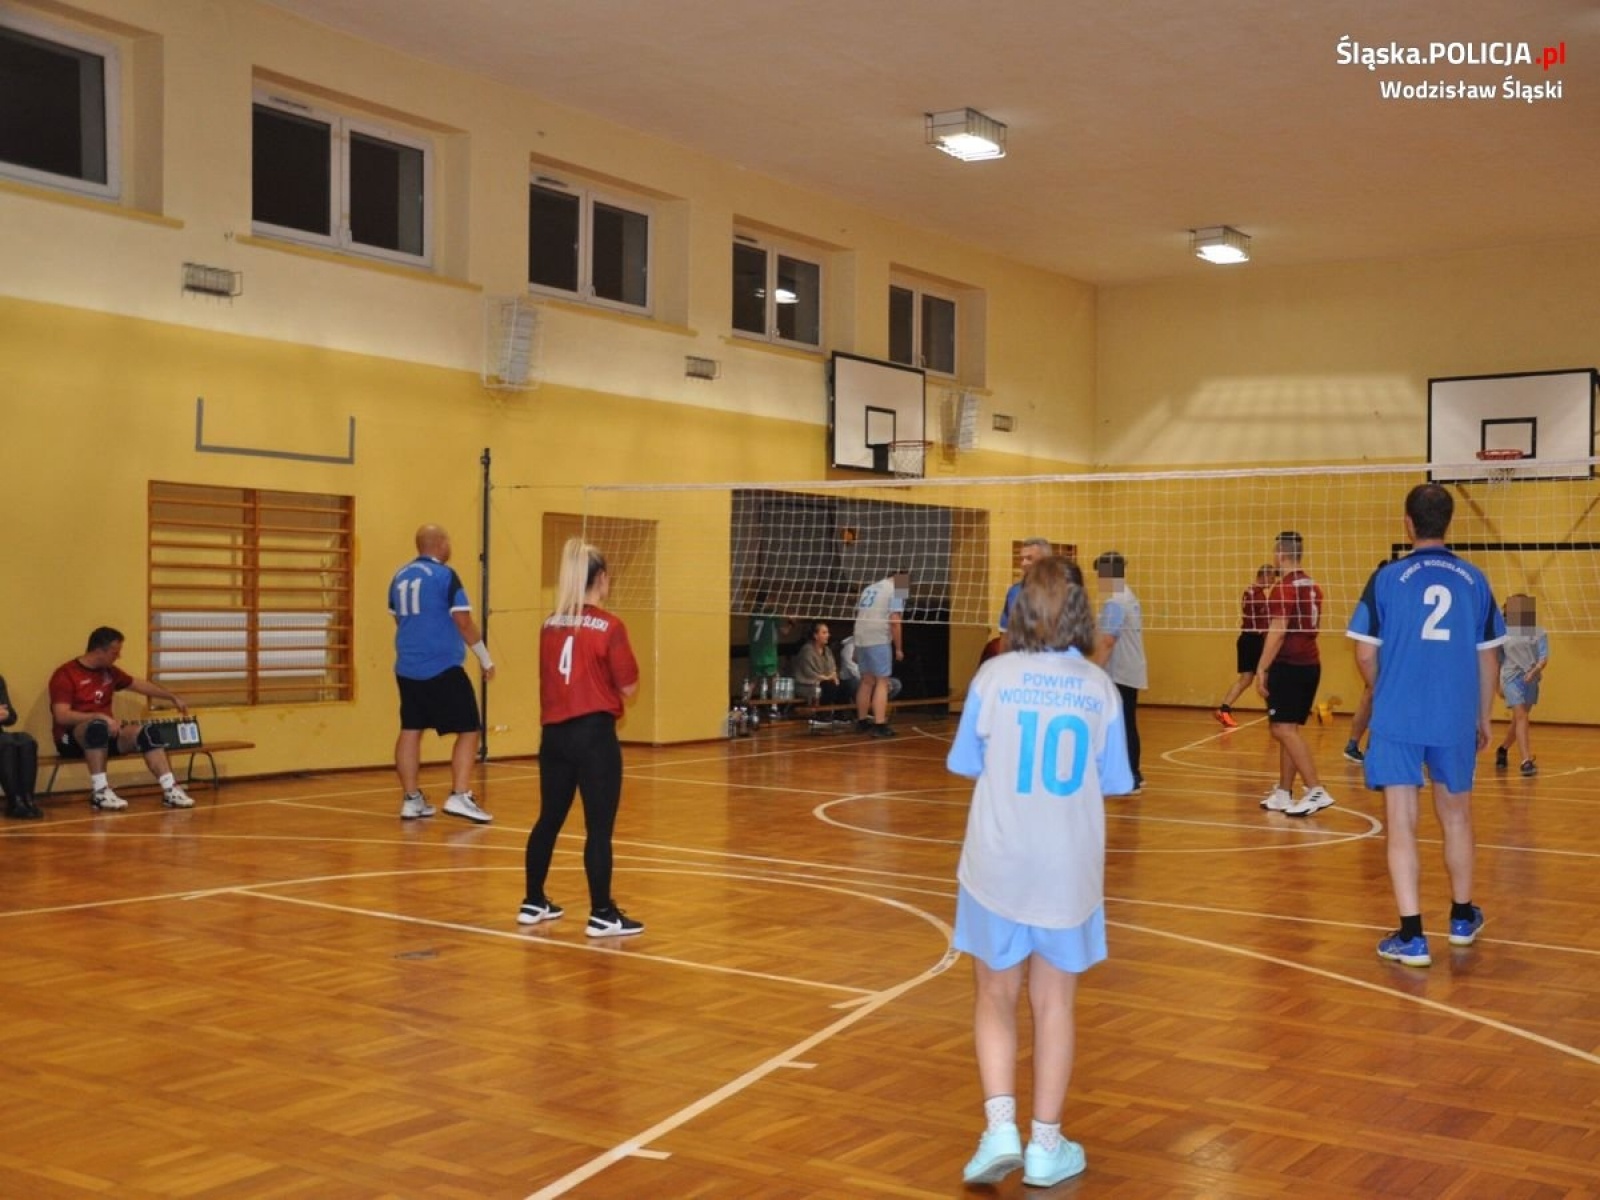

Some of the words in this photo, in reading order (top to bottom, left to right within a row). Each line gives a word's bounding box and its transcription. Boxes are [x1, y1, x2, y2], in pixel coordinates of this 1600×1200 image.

[397, 578, 421, 616] 11
[1421, 584, 1453, 641] 2
[754, 619, 765, 642] 7
[558, 635, 575, 685] 4
[1023, 673, 1085, 689] POWIAT
[1000, 688, 1103, 714] WODZISŁAWSKI
[1016, 710, 1089, 797] 10
